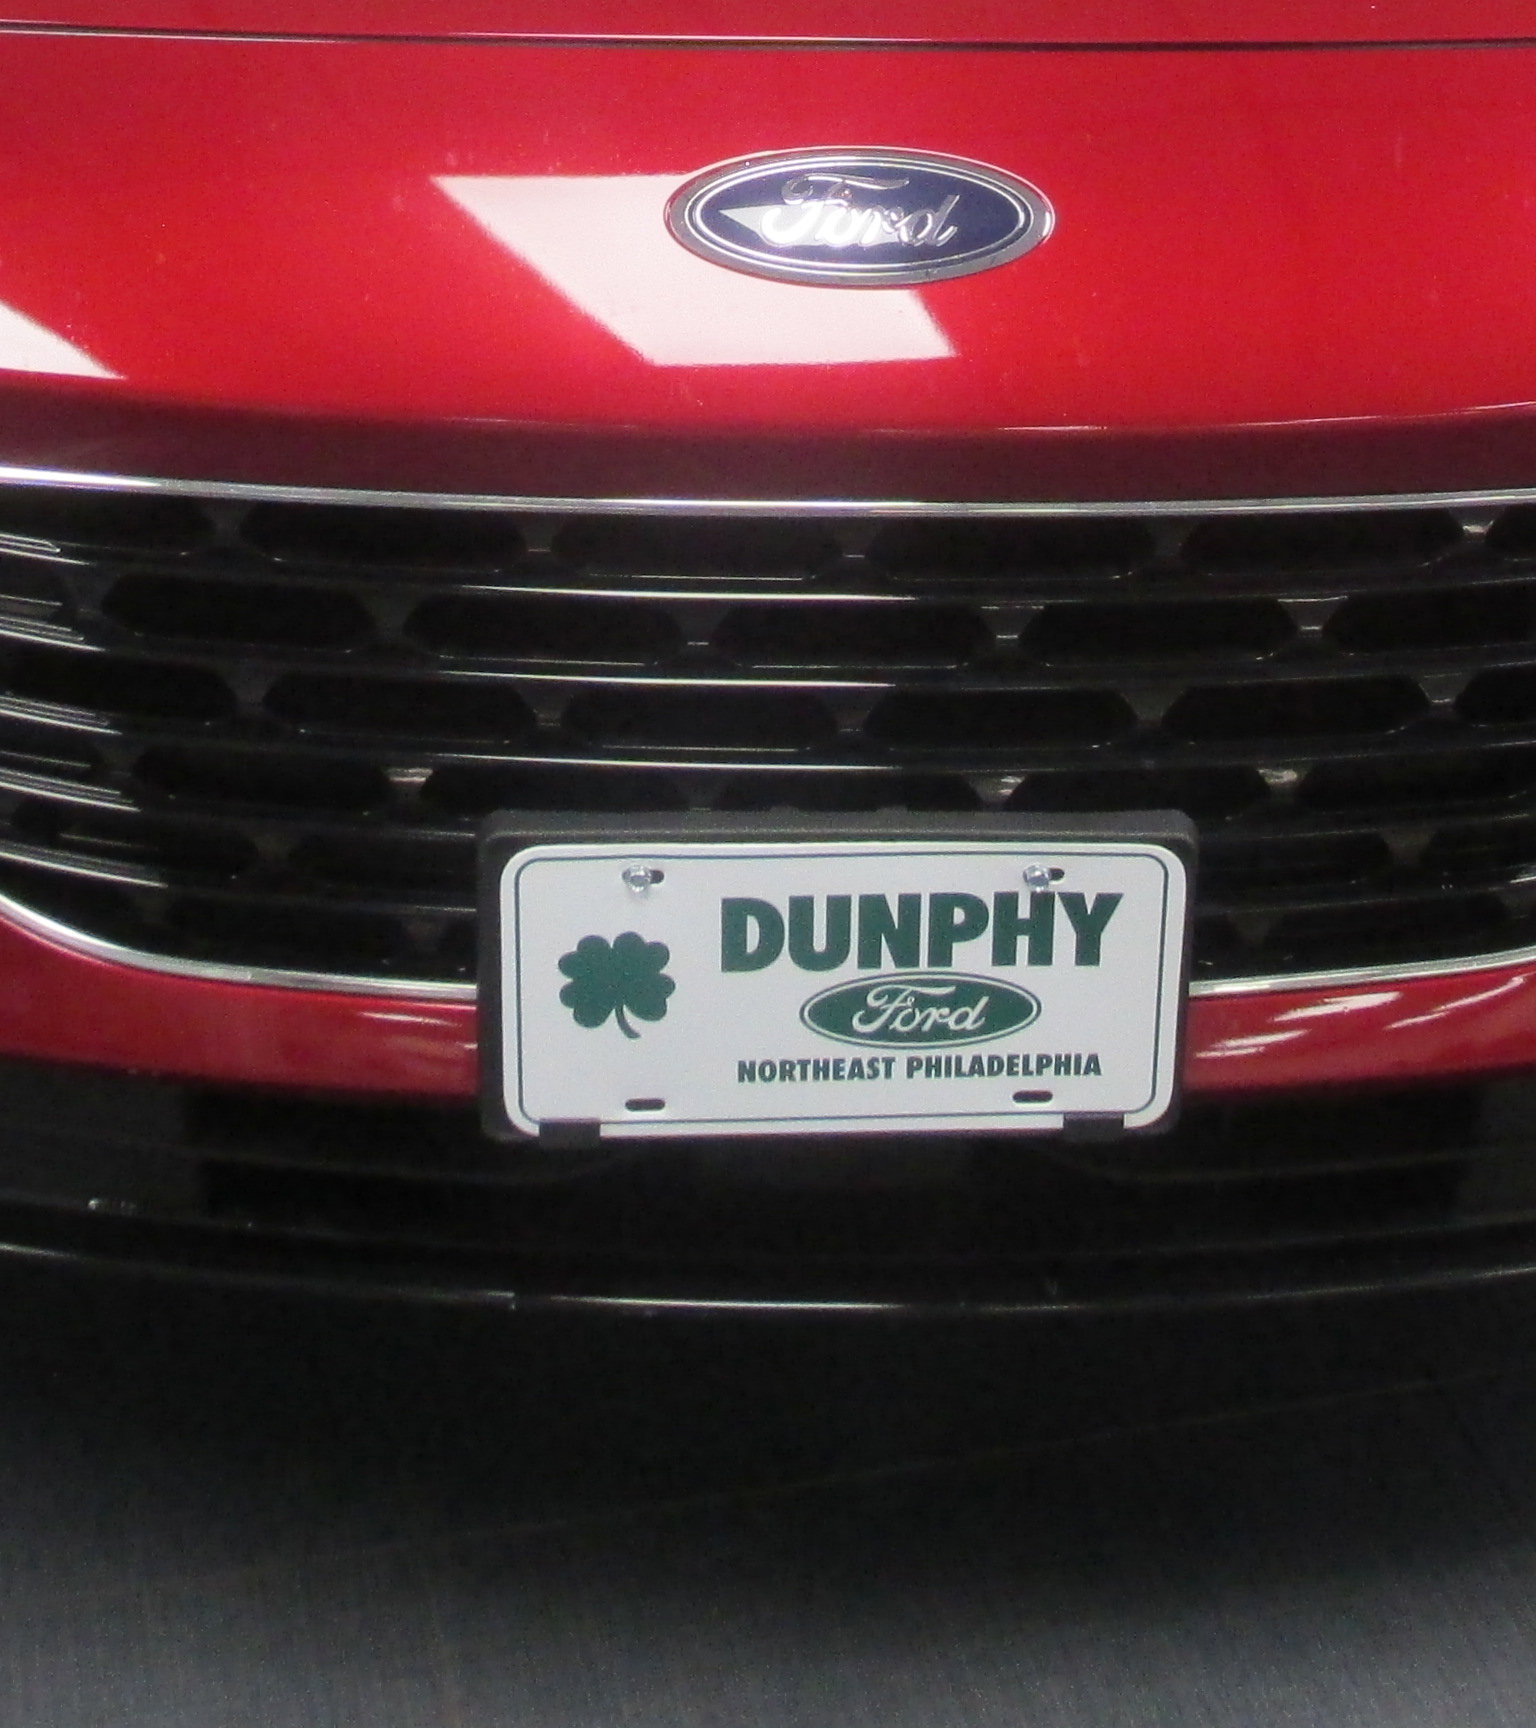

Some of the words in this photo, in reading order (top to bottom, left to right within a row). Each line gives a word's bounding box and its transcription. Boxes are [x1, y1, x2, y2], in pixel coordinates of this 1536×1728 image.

[760, 172, 960, 248] Ford
[721, 891, 1124, 972] DUNPHY
[851, 983, 987, 1035] Ford
[737, 1056, 895, 1083] NORTHEAST
[905, 1052, 1102, 1079] PHILADELPHIA
